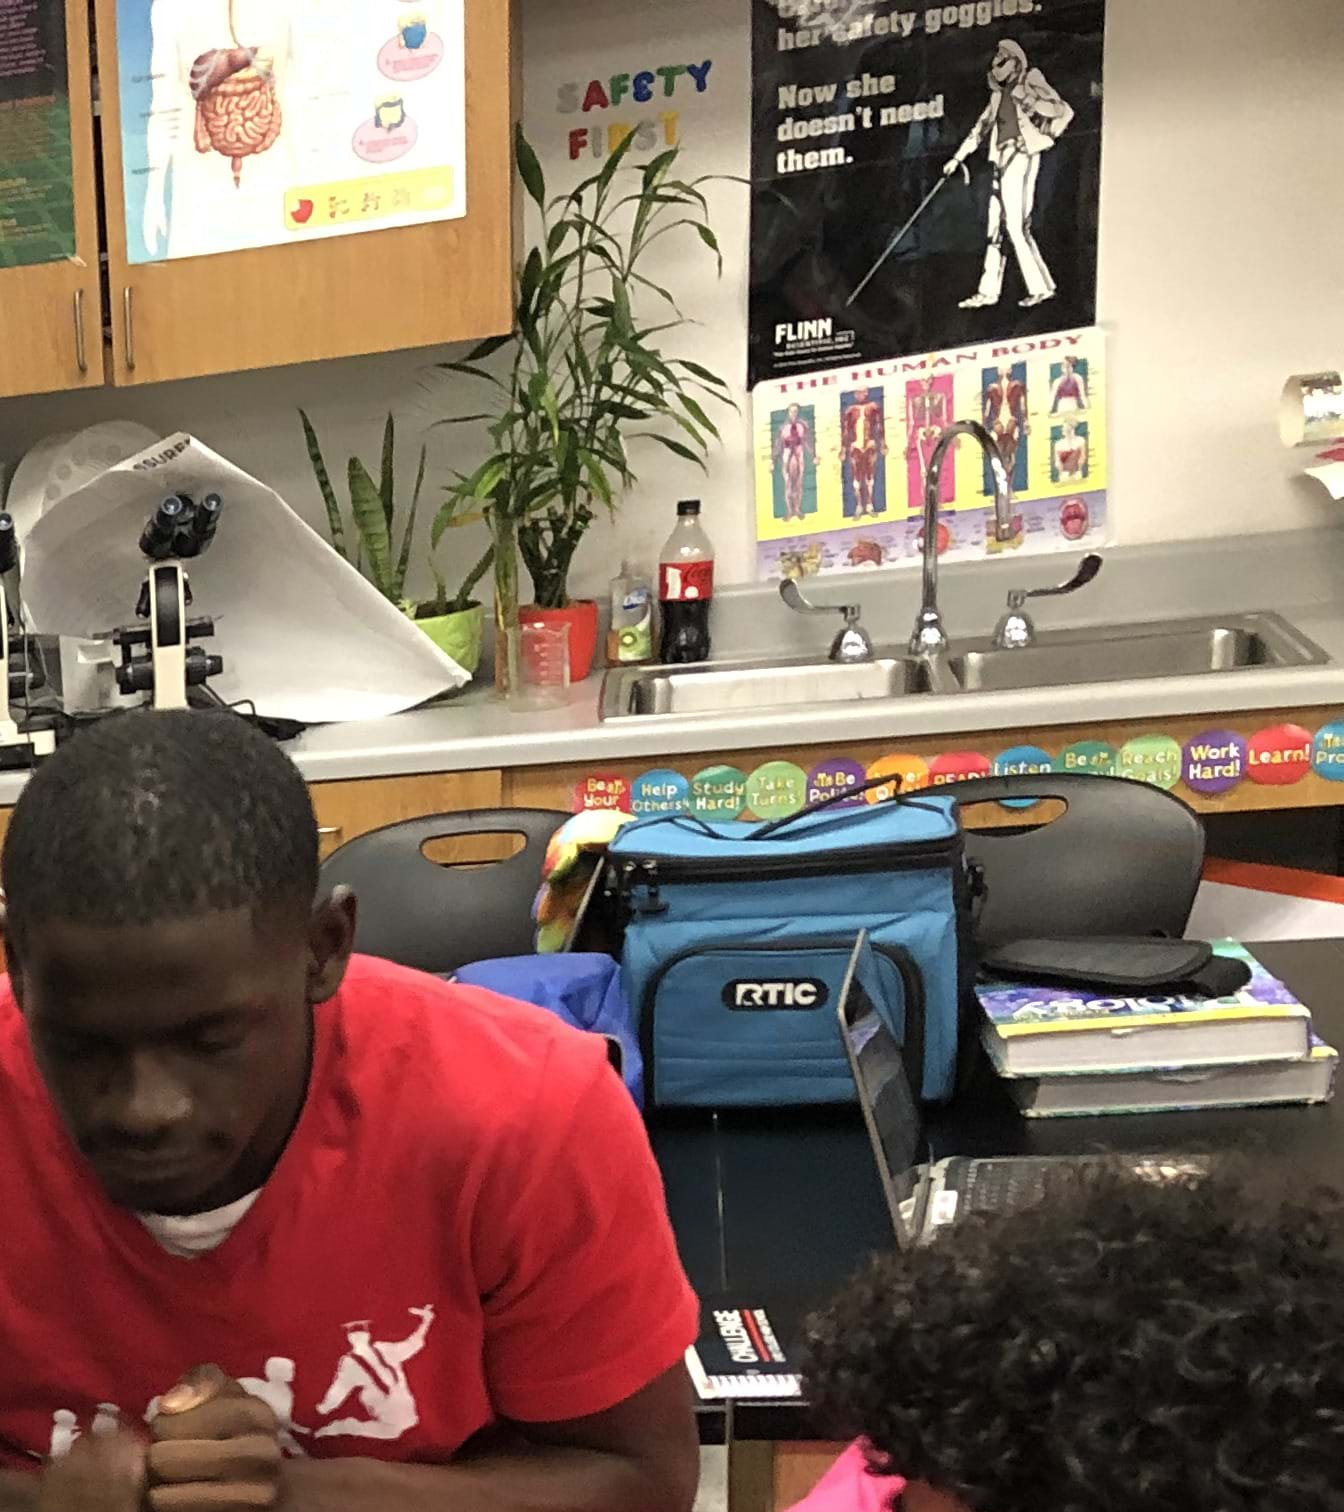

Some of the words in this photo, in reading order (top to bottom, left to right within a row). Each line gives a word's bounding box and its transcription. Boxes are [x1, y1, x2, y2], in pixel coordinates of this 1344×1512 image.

[777, 28, 820, 51] her
[556, 60, 712, 114] SAFETY
[778, 83, 837, 110] Now
[846, 73, 896, 99] she
[777, 106, 873, 142] doesn't
[880, 94, 945, 126] need
[569, 111, 679, 160] FIRST
[777, 147, 854, 174] them.
[775, 317, 833, 345] FLINN
[776, 375, 838, 394] THE
[852, 350, 978, 381] HUMAN
[991, 333, 1083, 359] BODY
[1065, 751, 1087, 768] Be
[1122, 750, 1177, 765] Reach
[1191, 742, 1240, 760] Work
[1249, 744, 1310, 765] Learn!
[994, 760, 1052, 776] Listen
[1189, 759, 1240, 779] Hard!
[693, 780, 745, 796] Study
[759, 777, 795, 790] Take
[835, 771, 856, 786] Be
[584, 793, 620, 807] Your
[641, 783, 679, 800] Help
[696, 795, 741, 810] Hard!
[735, 982, 817, 1006] RTIC
